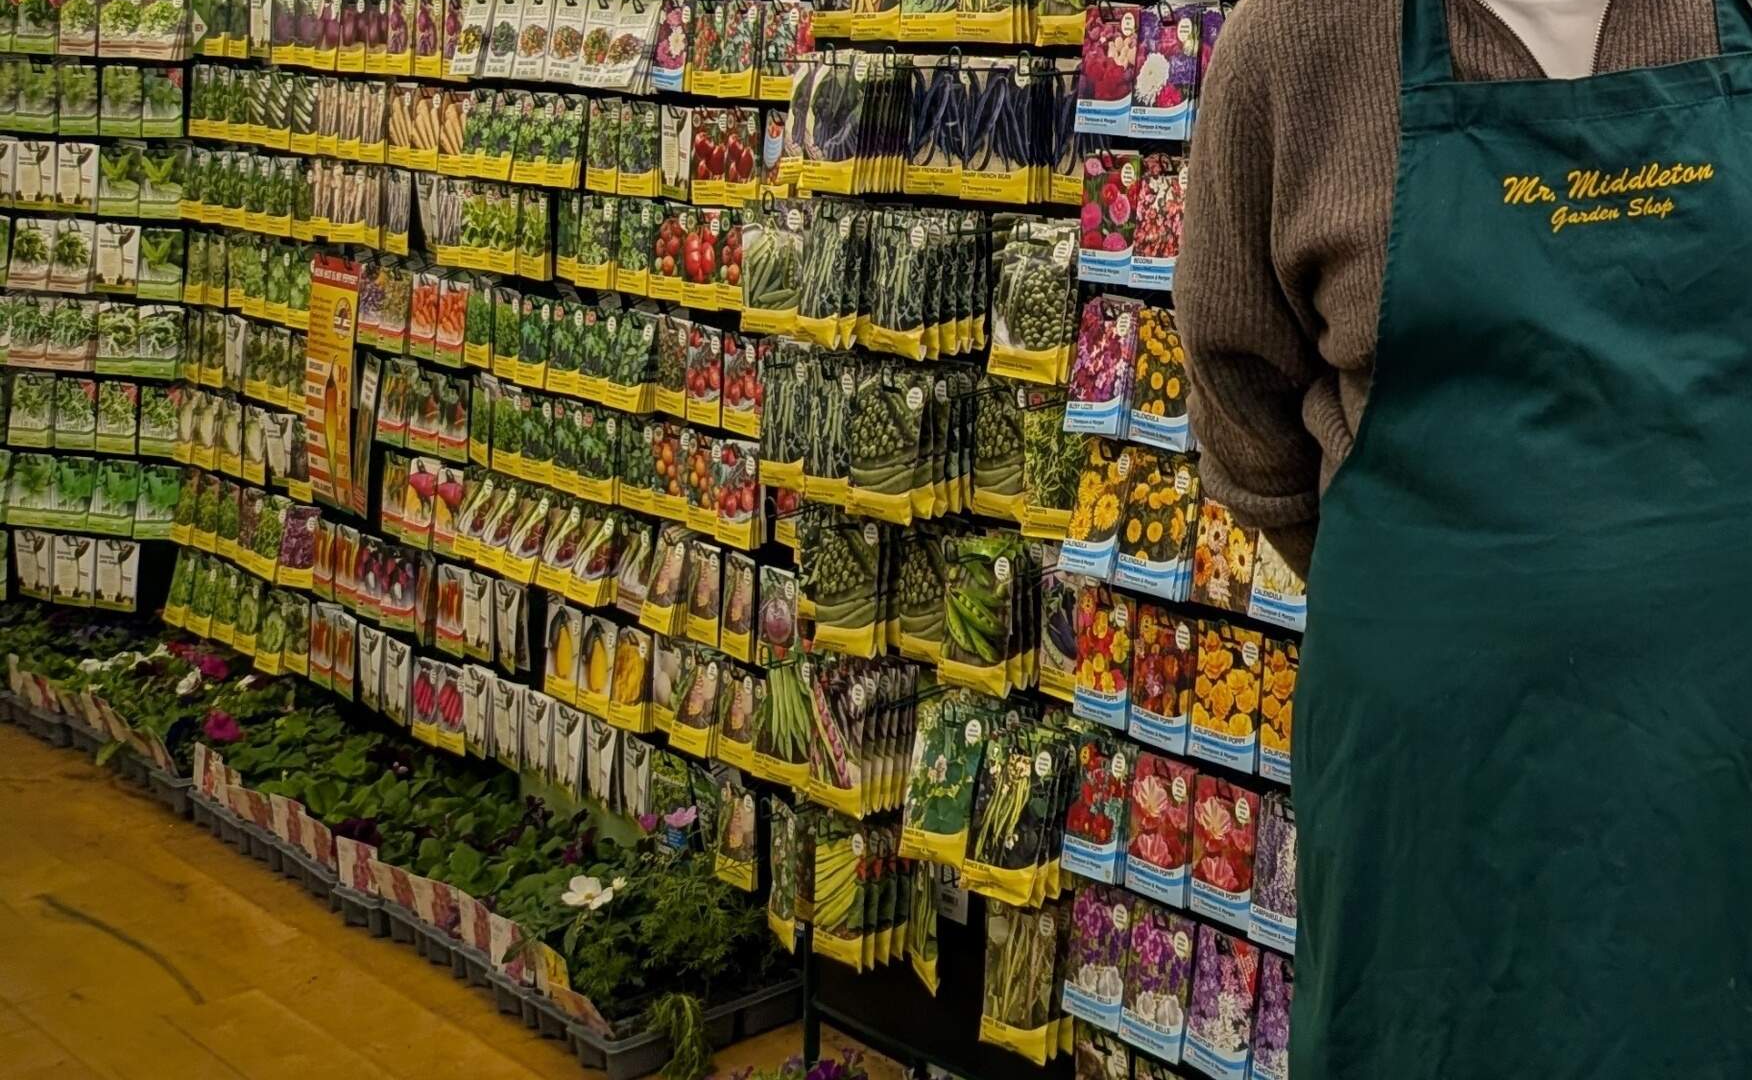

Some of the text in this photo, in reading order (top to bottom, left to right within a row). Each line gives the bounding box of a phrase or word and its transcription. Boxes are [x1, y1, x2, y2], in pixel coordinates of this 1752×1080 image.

[1503, 163, 1714, 204] Mr. Middleton
[1551, 196, 1674, 233] Garden Shop
